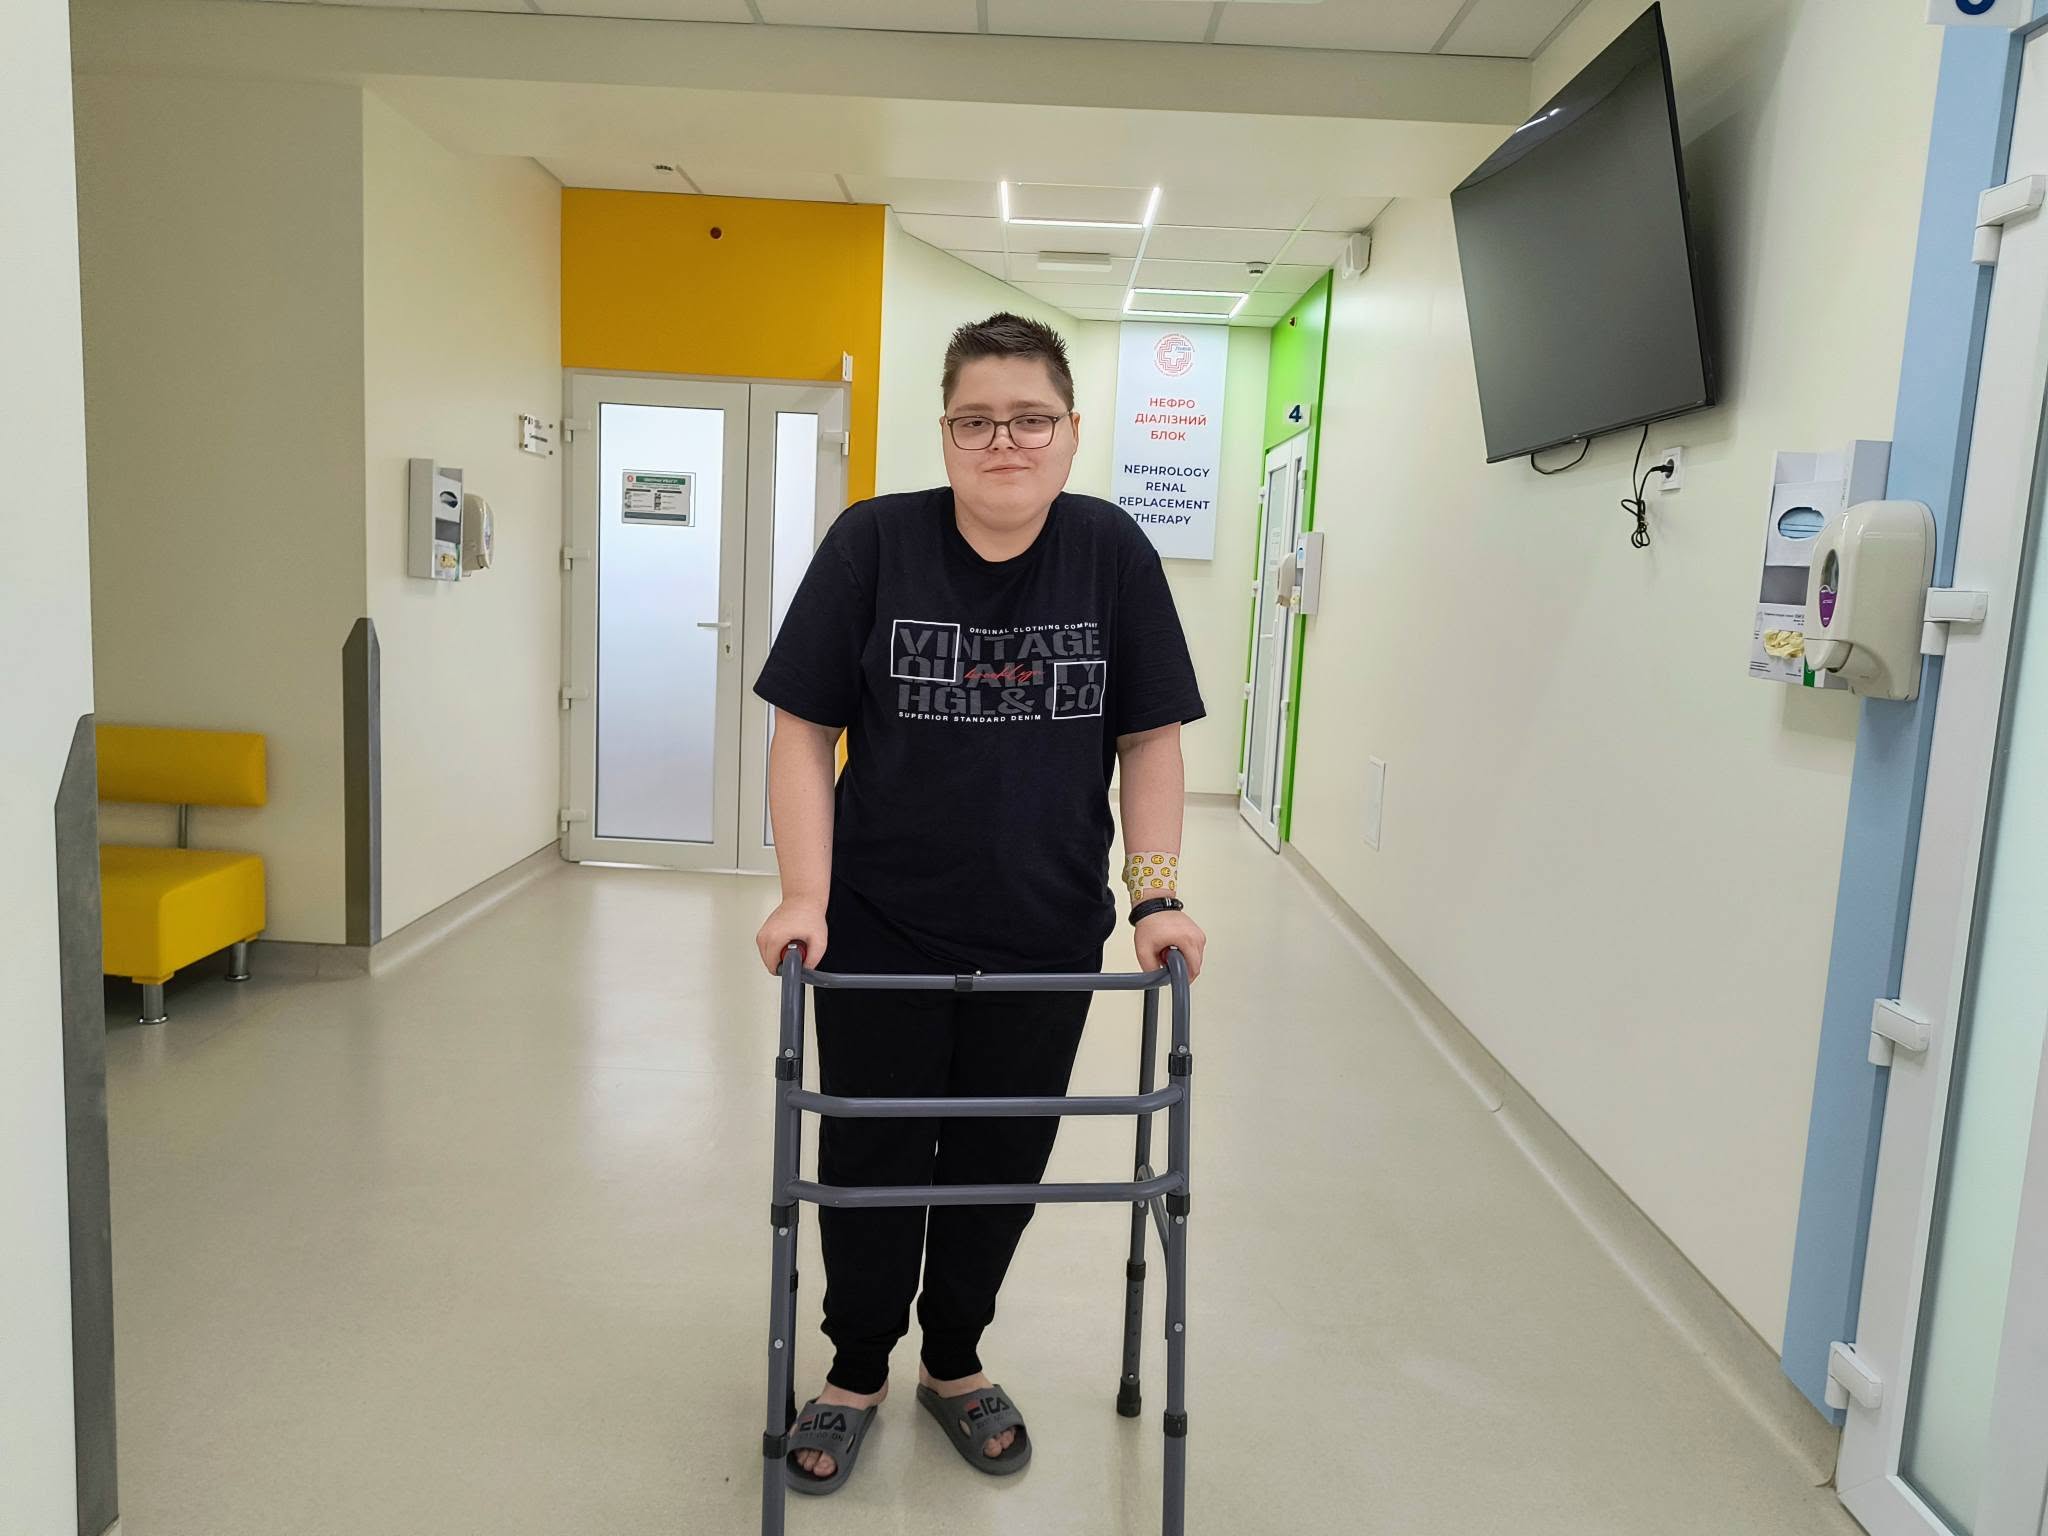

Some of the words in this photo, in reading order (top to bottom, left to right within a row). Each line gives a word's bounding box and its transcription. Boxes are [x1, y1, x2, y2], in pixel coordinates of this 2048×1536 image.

[1149, 397, 1196, 409] НЕФРО
[1134, 413, 1207, 426] ДІАЛІЗНИЙ
[1288, 404, 1303, 423] 4
[1150, 430, 1186, 441] БЛОК
[1124, 464, 1210, 478] NEPHROLOGY
[1145, 482, 1187, 493] RENAL
[1119, 496, 1210, 510] REPLACEMENT
[1133, 513, 1192, 525] THERAPY
[969, 627, 1010, 635] ORIGINAL
[1013, 624, 1060, 633] CLOTHING
[1064, 622, 1098, 630] COMPANY
[900, 628, 1101, 661] VINTAGE
[898, 655, 1102, 688] QUALITY
[898, 711, 949, 722] SUPERIOR
[1010, 714, 1041, 722] DENIM
